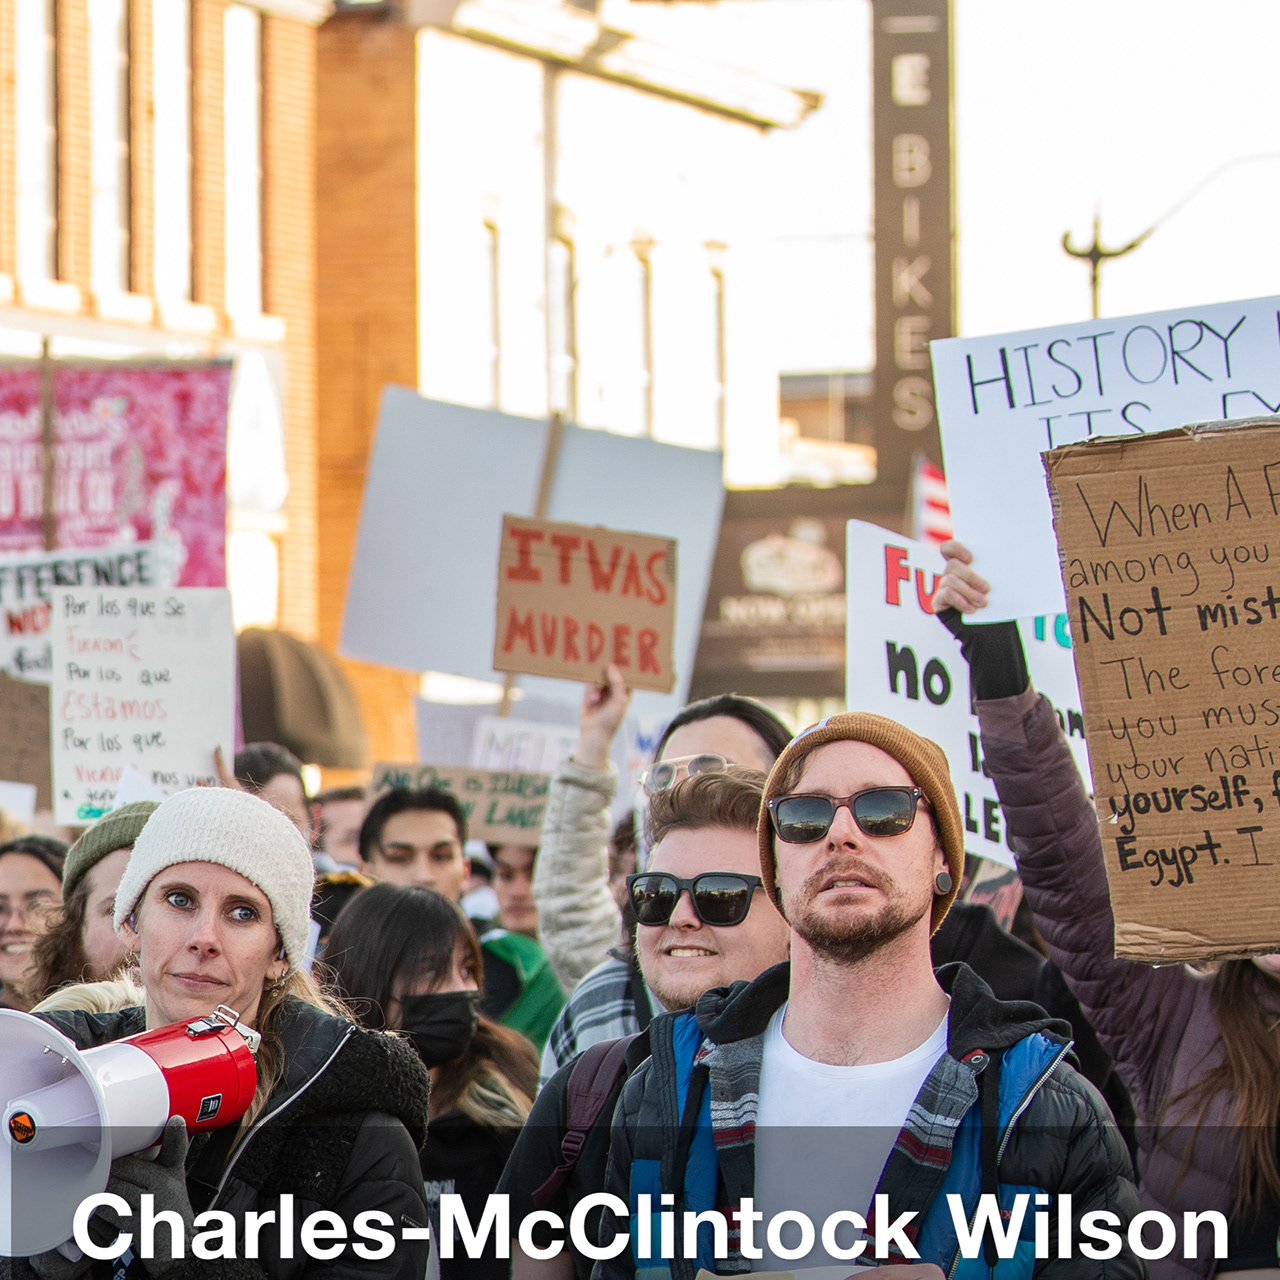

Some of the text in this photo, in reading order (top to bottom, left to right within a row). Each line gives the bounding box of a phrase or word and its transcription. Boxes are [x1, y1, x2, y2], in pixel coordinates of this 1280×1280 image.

[965, 315, 1247, 415] HISTORY
[1076, 475, 1211, 547] When
[1225, 465, 1252, 521] A
[1069, 544, 1270, 597] among you
[501, 602, 662, 677] MURDER
[1079, 586, 1172, 643] Not
[1099, 656, 1191, 700] The
[1106, 734, 1280, 797] your nati
[1107, 714, 1178, 768] you
[1109, 774, 1264, 836] yourself,
[1114, 825, 1274, 888] Egypt. I
